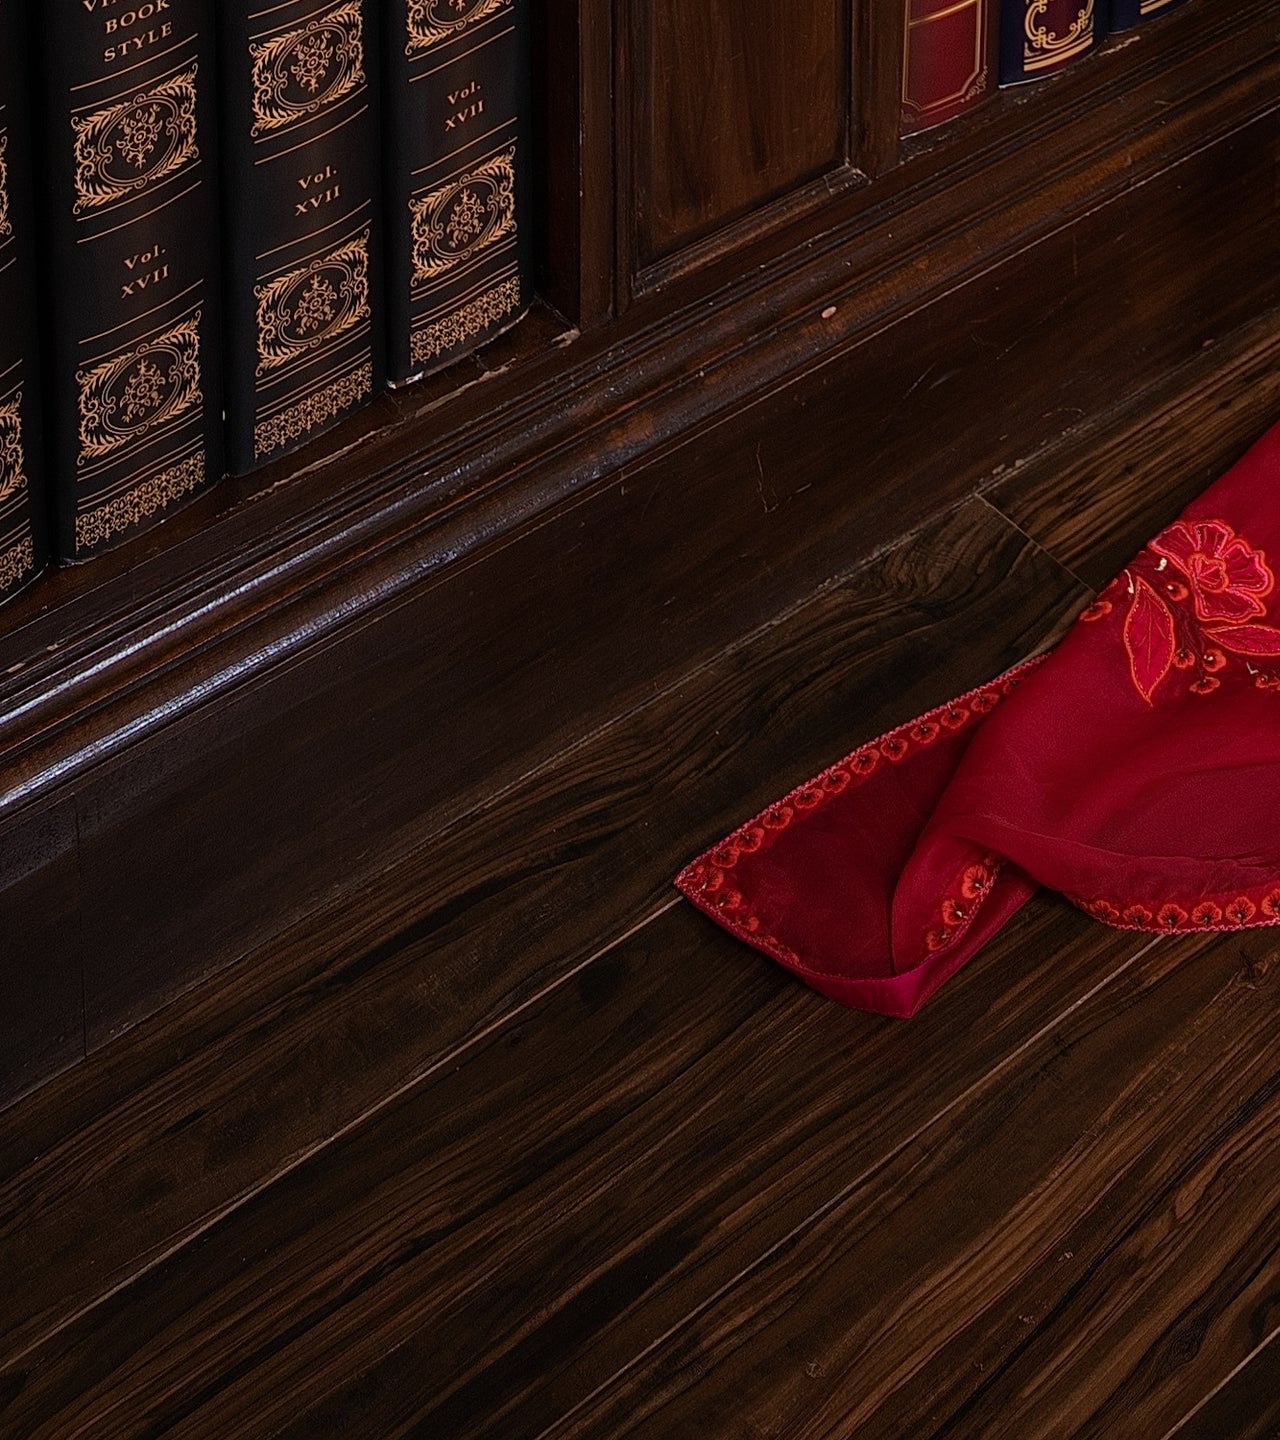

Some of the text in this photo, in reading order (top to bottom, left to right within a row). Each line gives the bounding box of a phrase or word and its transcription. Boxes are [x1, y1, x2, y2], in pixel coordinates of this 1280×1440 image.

[104, 21, 172, 62] STYLE
[447, 81, 481, 105] Vol.
[445, 100, 483, 132] XVII
[298, 165, 337, 189] Vol.
[295, 185, 339, 216] XVII
[123, 244, 166, 270] Vol.
[121, 264, 169, 299] XVII
